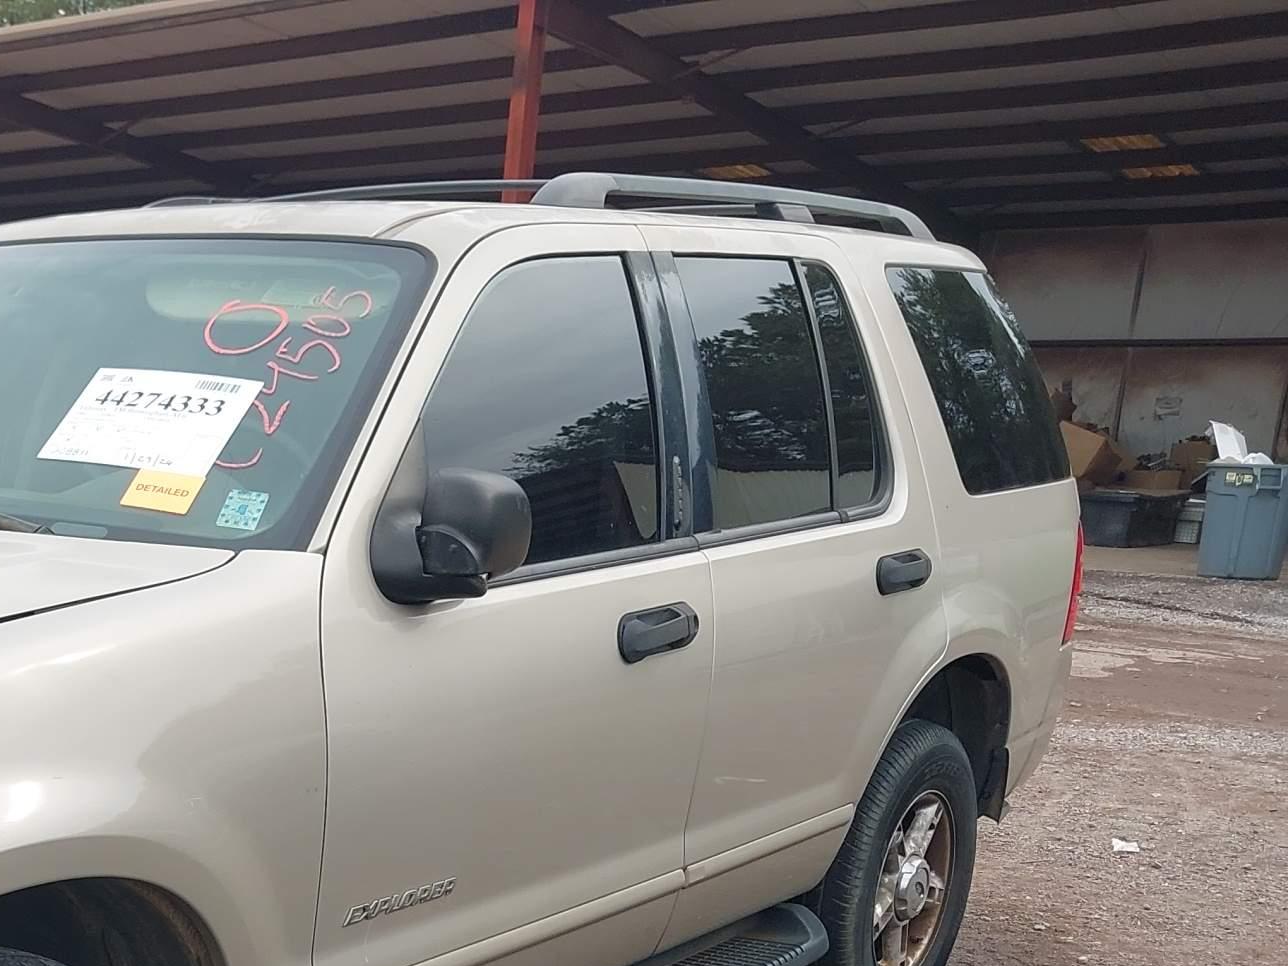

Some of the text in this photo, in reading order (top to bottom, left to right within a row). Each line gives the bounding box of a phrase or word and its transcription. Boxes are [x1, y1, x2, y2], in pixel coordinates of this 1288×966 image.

[95, 389, 226, 416] 44274333
[135, 483, 190, 498] DETAILED
[343, 876, 457, 928] EXPLORER
